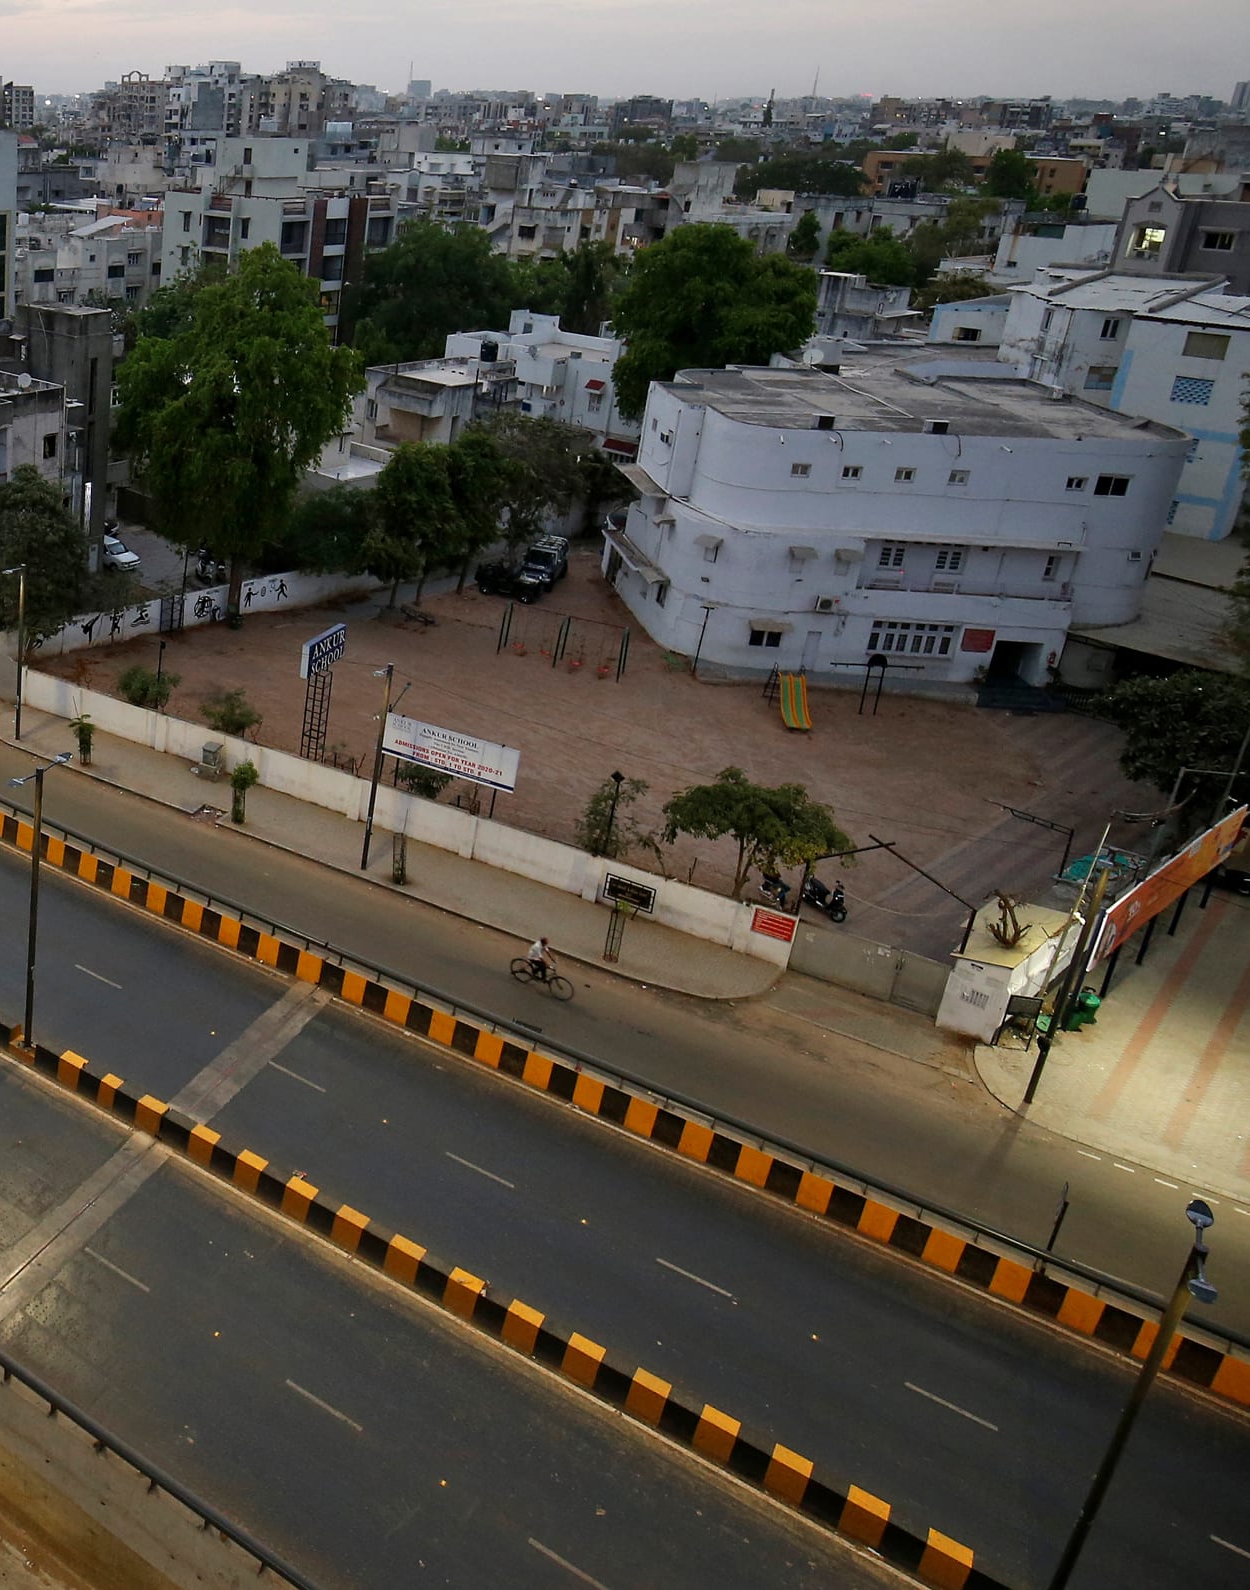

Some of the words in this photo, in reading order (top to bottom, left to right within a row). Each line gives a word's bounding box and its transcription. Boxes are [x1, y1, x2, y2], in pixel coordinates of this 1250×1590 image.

[312, 629, 346, 660] ANKUR
[310, 645, 344, 676] SCHOOL
[422, 728, 447, 740] ANKUR
[448, 734, 478, 749] SCHOOL
[394, 739, 430, 754] ADMISSIONS
[431, 748, 446, 759] OPEN
[447, 752, 460, 763] FOR
[461, 757, 476, 769] YEAR
[477, 763, 503, 777] 2020-21
[454, 763, 462, 771] TO
